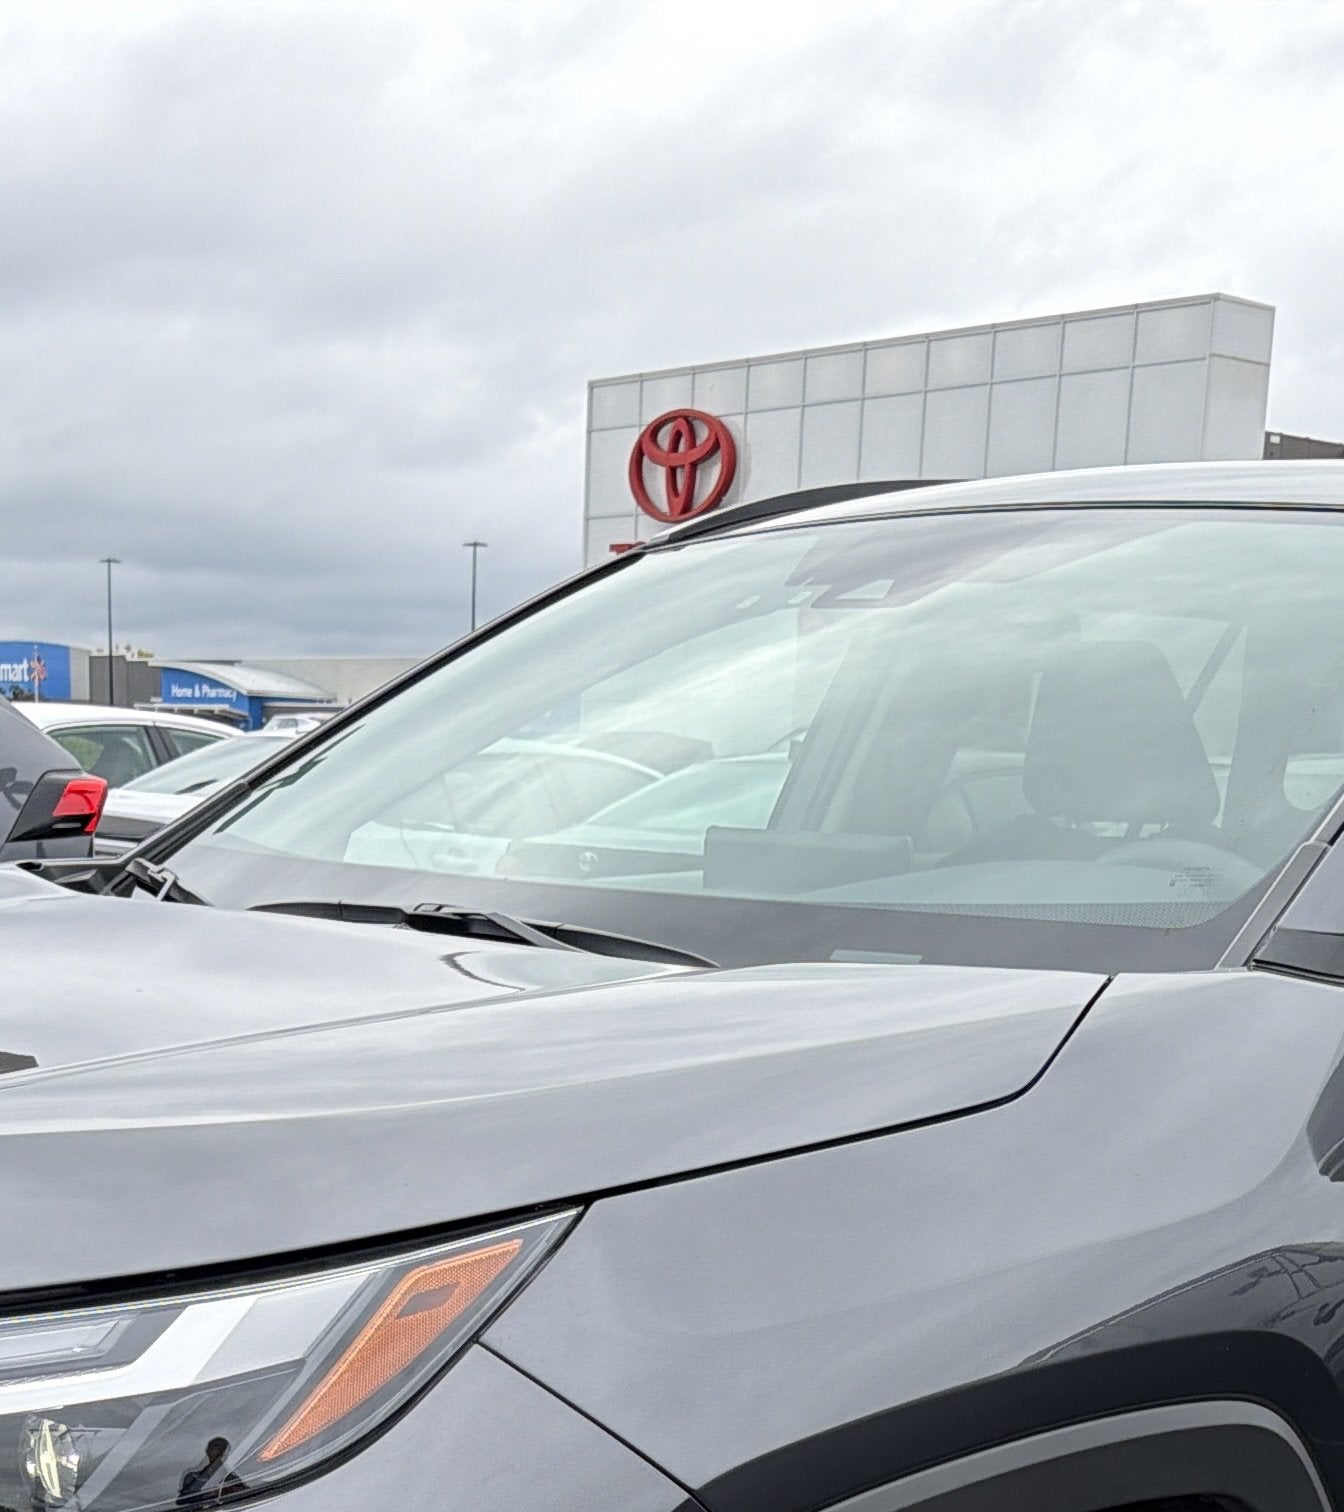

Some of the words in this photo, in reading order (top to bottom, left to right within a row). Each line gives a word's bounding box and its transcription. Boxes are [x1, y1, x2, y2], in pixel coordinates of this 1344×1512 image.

[170, 684, 193, 698] Home
[194, 684, 201, 698] &
[202, 684, 238, 703] Pharmacy
